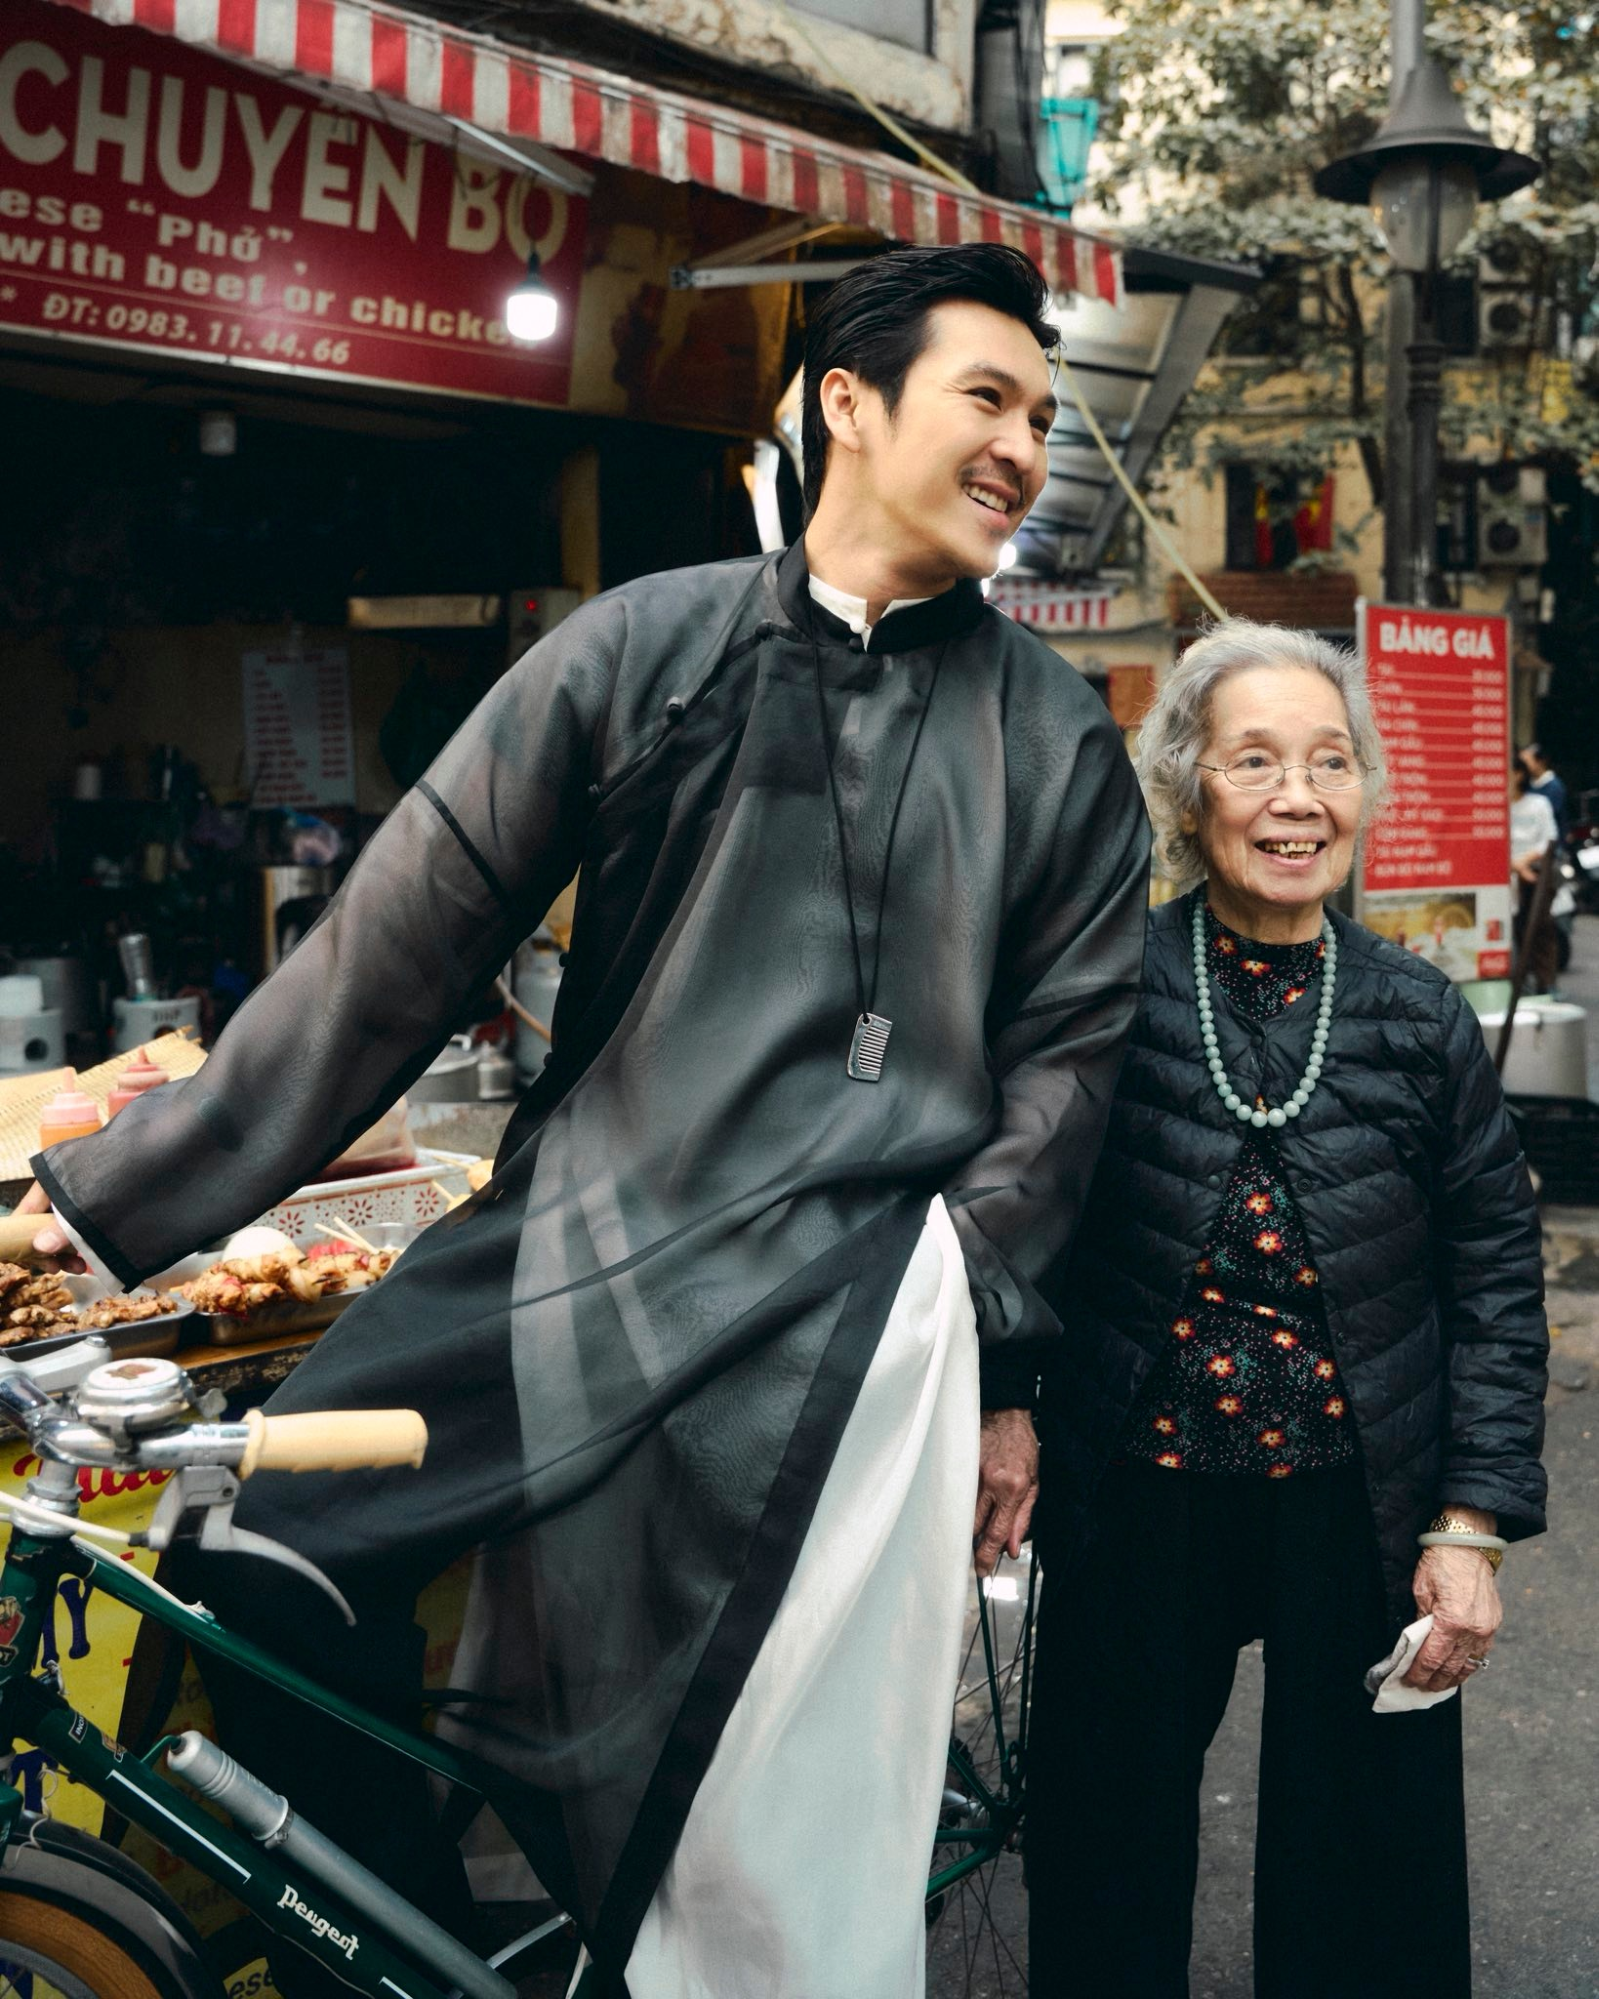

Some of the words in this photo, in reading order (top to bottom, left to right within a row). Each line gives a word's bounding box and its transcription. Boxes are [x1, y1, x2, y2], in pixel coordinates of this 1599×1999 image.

[0, 232, 125, 281] with
[145, 254, 267, 306] beef
[283, 284, 336, 316] or
[350, 294, 530, 349] chicke
[1452, 624, 1495, 660] GIÁ
[276, 1882, 360, 1961] Peugeot
